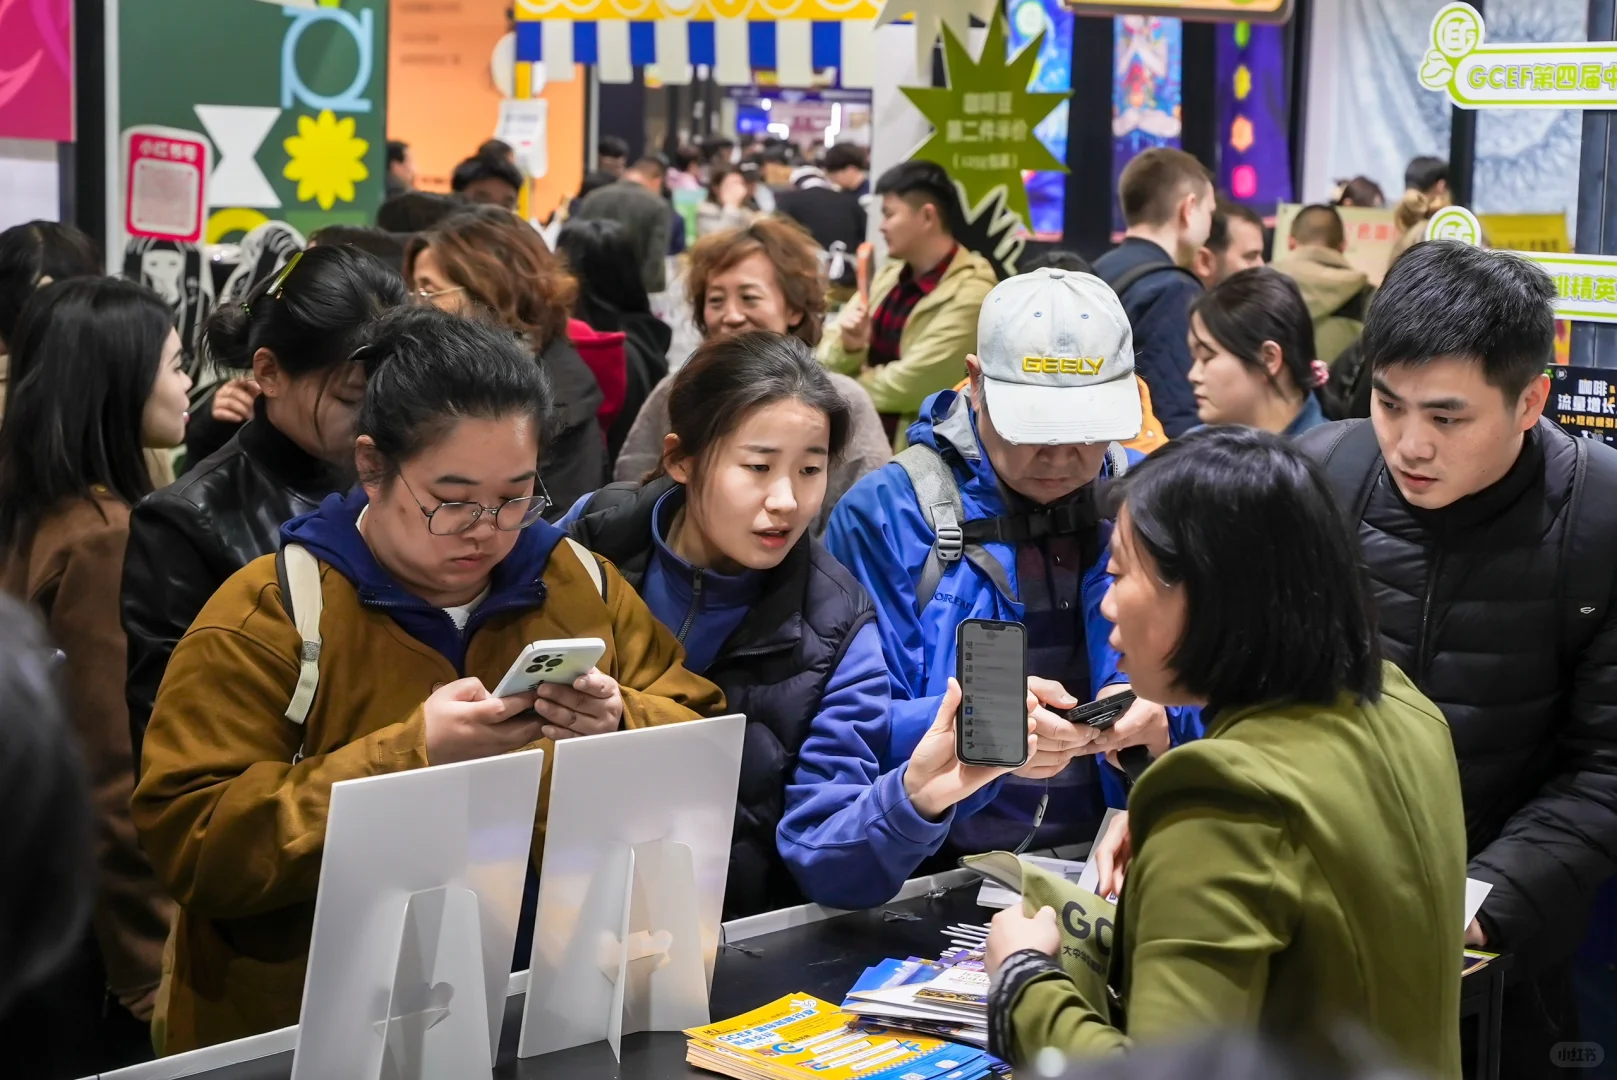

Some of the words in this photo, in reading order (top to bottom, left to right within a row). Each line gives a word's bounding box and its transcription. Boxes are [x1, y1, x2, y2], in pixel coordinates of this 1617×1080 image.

[1022, 356, 1104, 376] GEELY
[1578, 379, 1608, 397] 咖啡
[1557, 393, 1616, 415] 流量增长
[717, 1030, 752, 1042] GCEF
